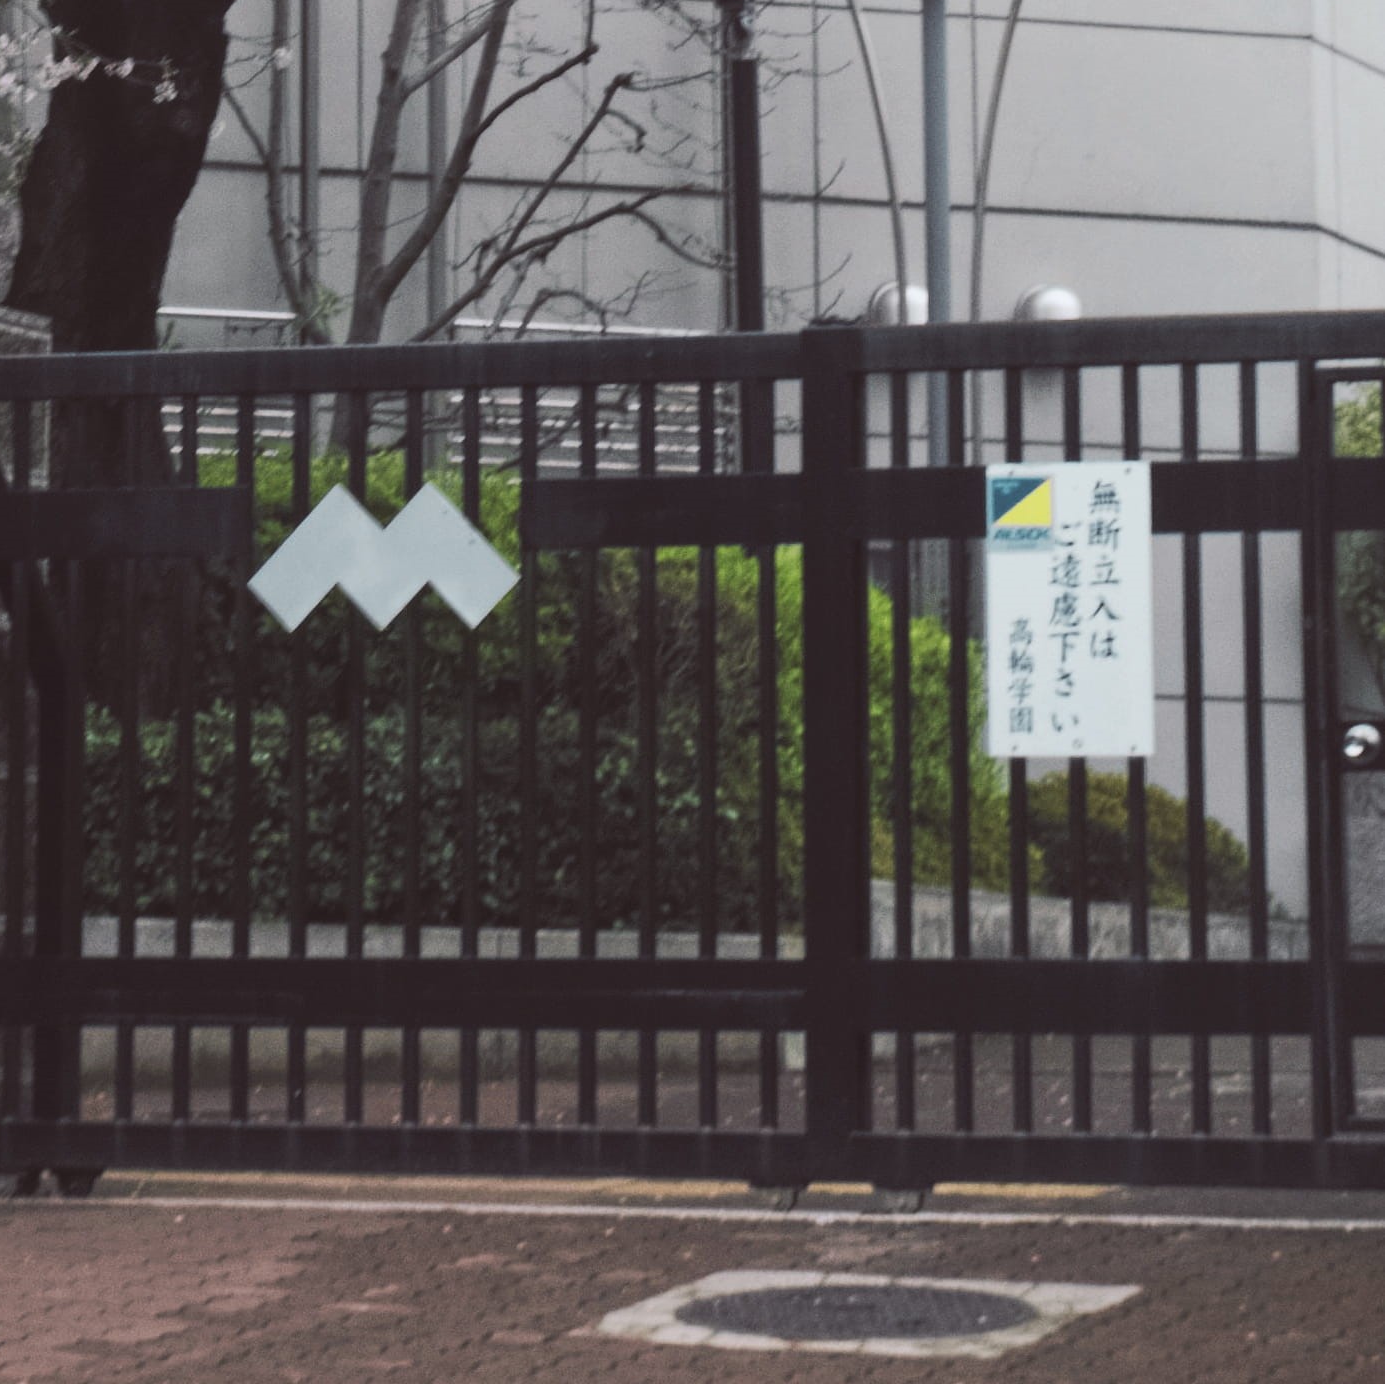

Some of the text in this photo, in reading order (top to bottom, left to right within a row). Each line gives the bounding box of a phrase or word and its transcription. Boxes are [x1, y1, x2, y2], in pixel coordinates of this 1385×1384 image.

[1088, 480, 1121, 659] 無断立入は
